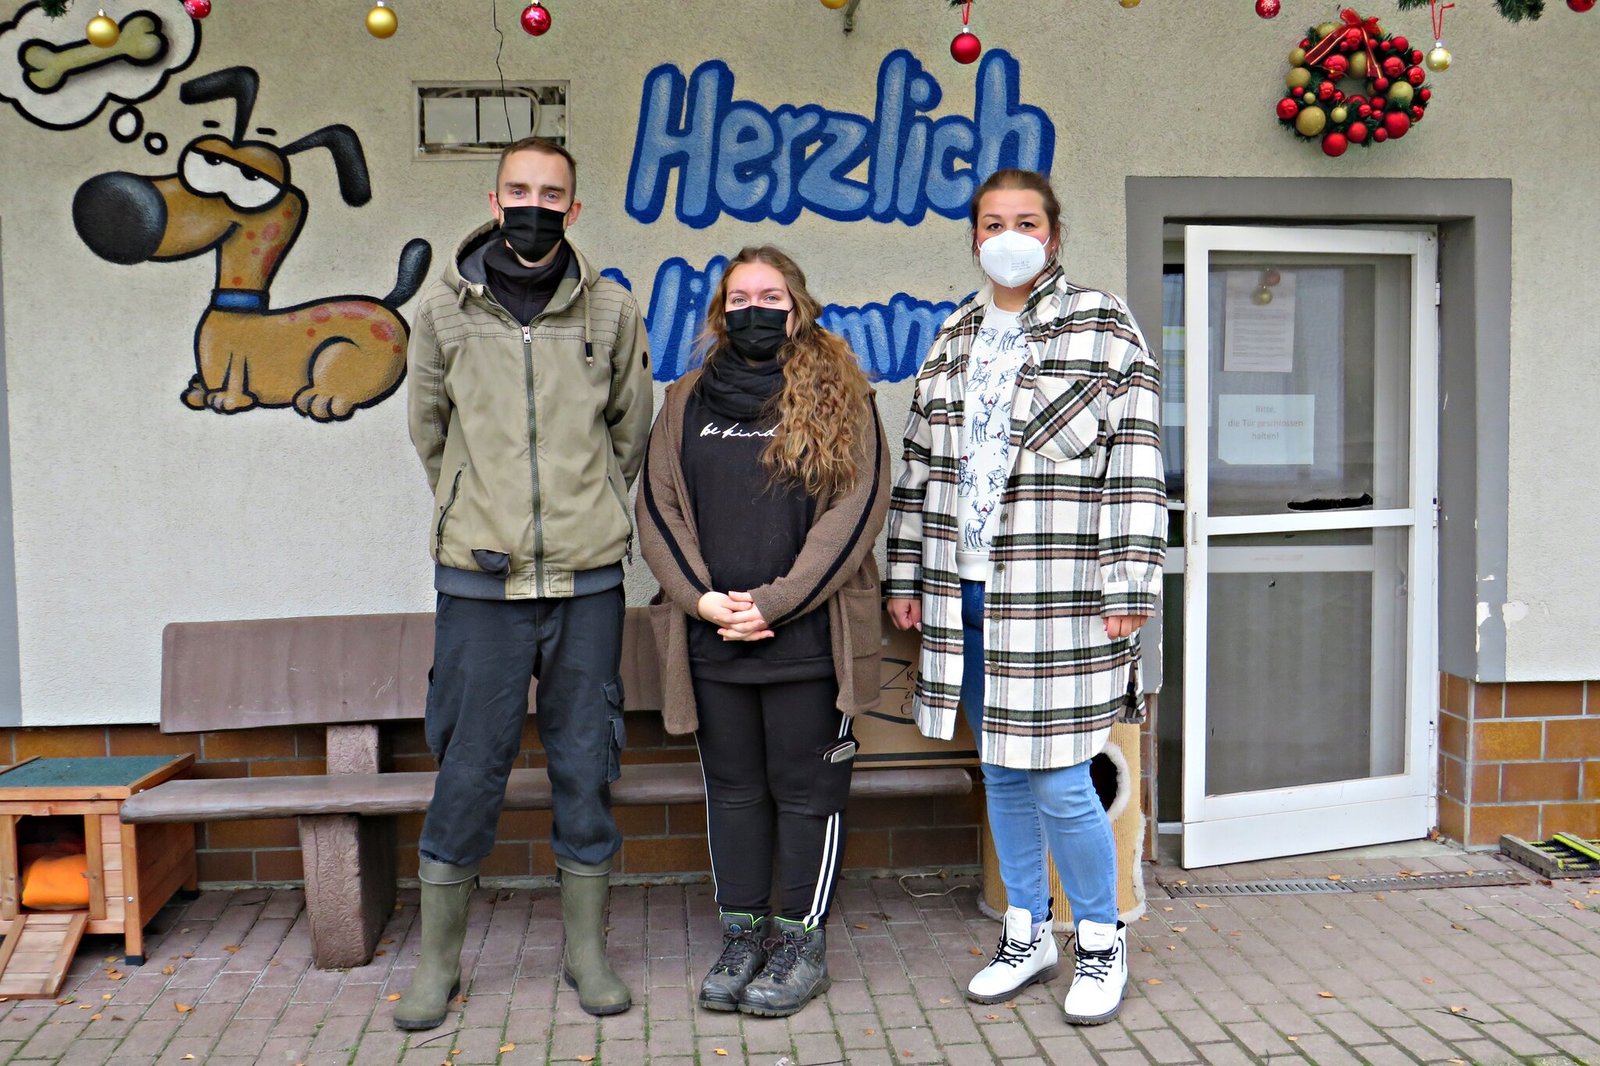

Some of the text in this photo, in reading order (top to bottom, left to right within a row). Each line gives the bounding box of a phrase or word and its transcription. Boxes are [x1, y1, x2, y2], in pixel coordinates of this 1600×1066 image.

[624, 48, 1056, 228] Herzlich
[700, 420, 783, 438] be kind
[1227, 418, 1240, 427] die
[1256, 418, 1304, 428] geschlossen
[1251, 431, 1280, 440] halten!
